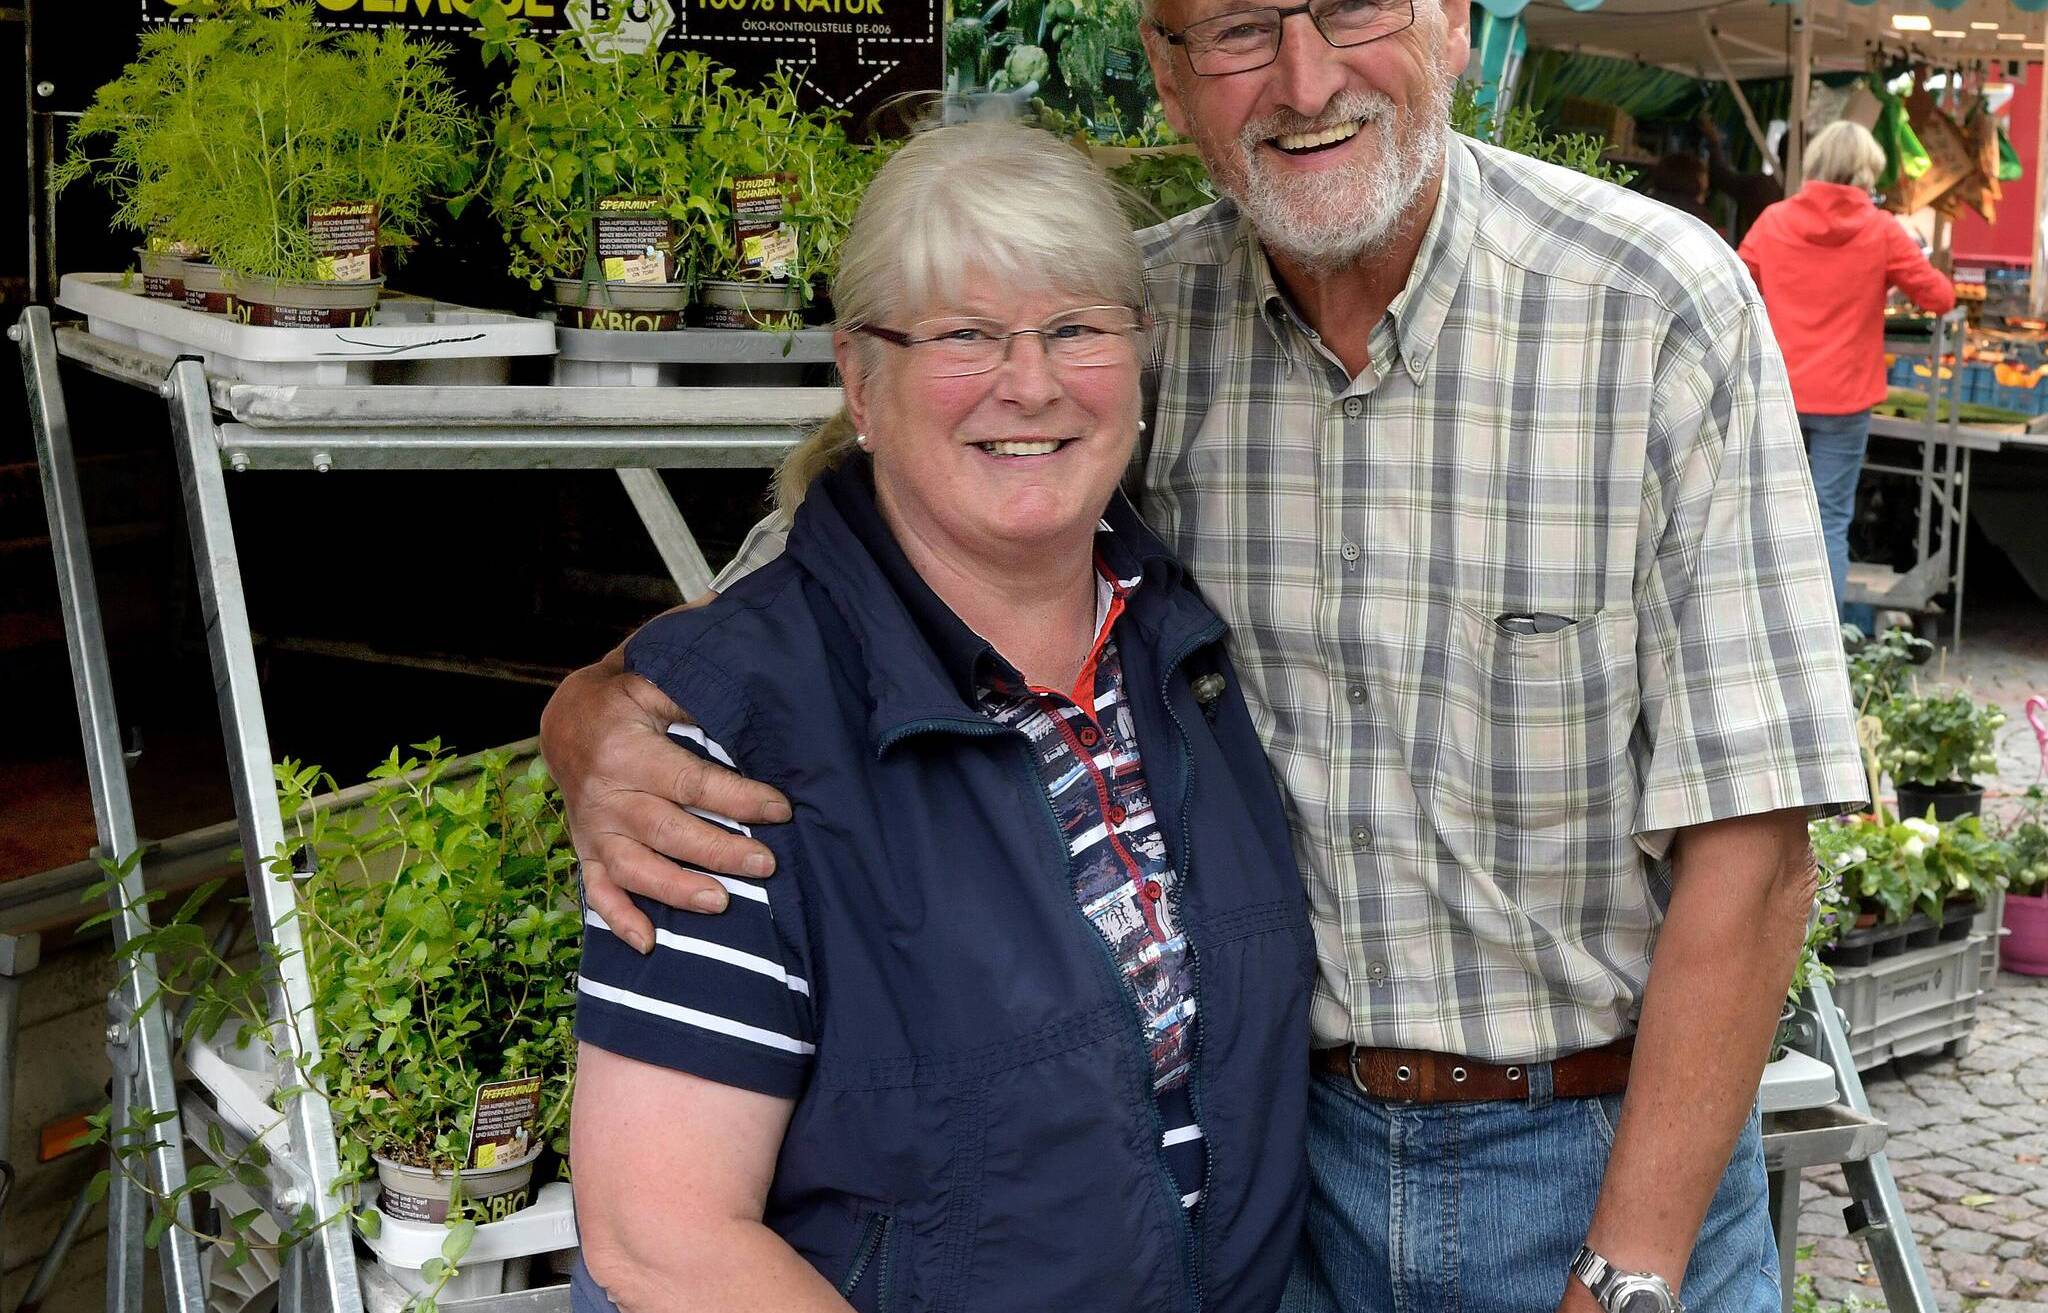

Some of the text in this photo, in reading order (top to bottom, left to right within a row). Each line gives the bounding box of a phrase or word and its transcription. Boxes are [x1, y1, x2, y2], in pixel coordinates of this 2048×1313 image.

[742, 18, 892, 34] ÖKO-KONTROLLSTELLE DE-006
[736, 177, 776, 190] STAUDEN
[313, 204, 374, 217] COLAPFLANZE
[599, 200, 657, 210] SPEARMINT
[481, 1082, 541, 1100] PFEFFERMINZE
